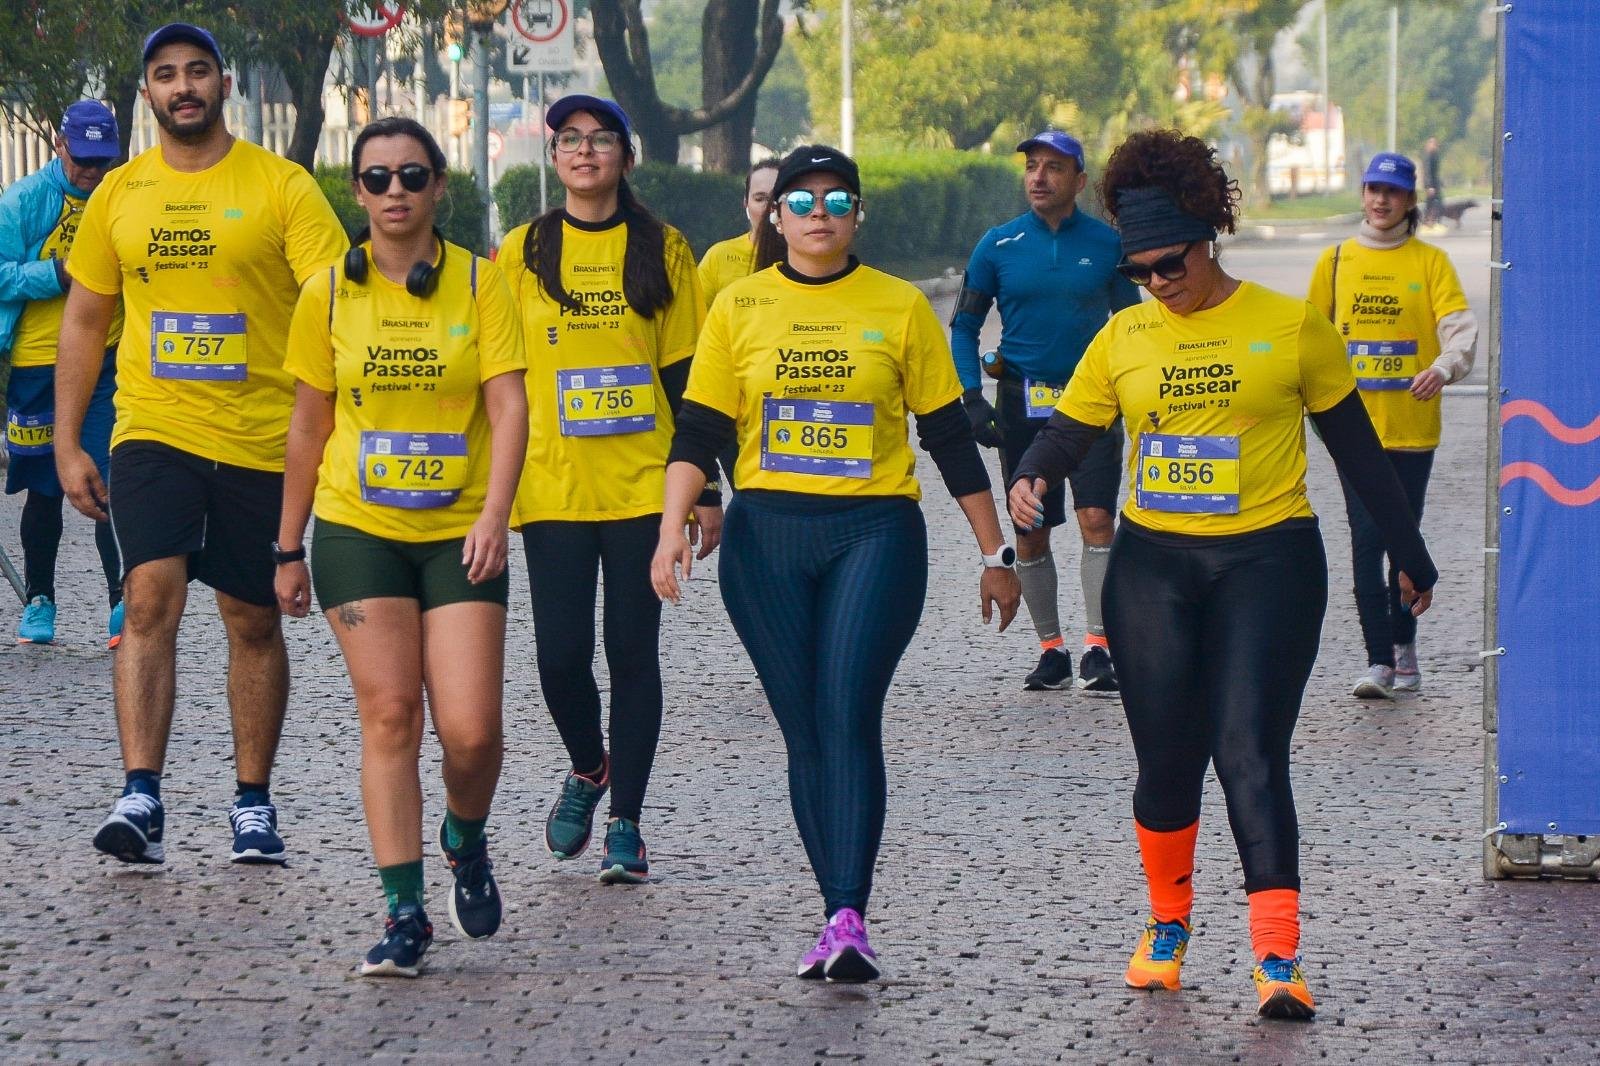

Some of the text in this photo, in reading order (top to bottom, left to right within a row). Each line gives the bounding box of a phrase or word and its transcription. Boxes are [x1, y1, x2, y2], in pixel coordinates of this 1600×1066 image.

[165, 204, 208, 212] BRASILPREV
[147, 243, 217, 257] Passear
[154, 261, 188, 271] festival
[1352, 303, 1403, 316] Passear
[381, 319, 430, 328] BRASILPREV
[567, 321, 619, 331] festival 23
[793, 323, 842, 332] BRASILPREV
[183, 336, 225, 356] 757
[1178, 339, 1228, 350] BRASILPREV
[363, 362, 447, 378] Passear
[1373, 357, 1403, 371] 789
[776, 364, 856, 380] Passear
[371, 382, 436, 393] festival 23
[783, 384, 845, 396] festival 23
[1159, 380, 1241, 399] Passear
[592, 389, 633, 410] 756
[1167, 399, 1230, 414] festival 23
[801, 425, 848, 449] 865
[398, 459, 444, 480] 742
[1168, 461, 1214, 484] 856
